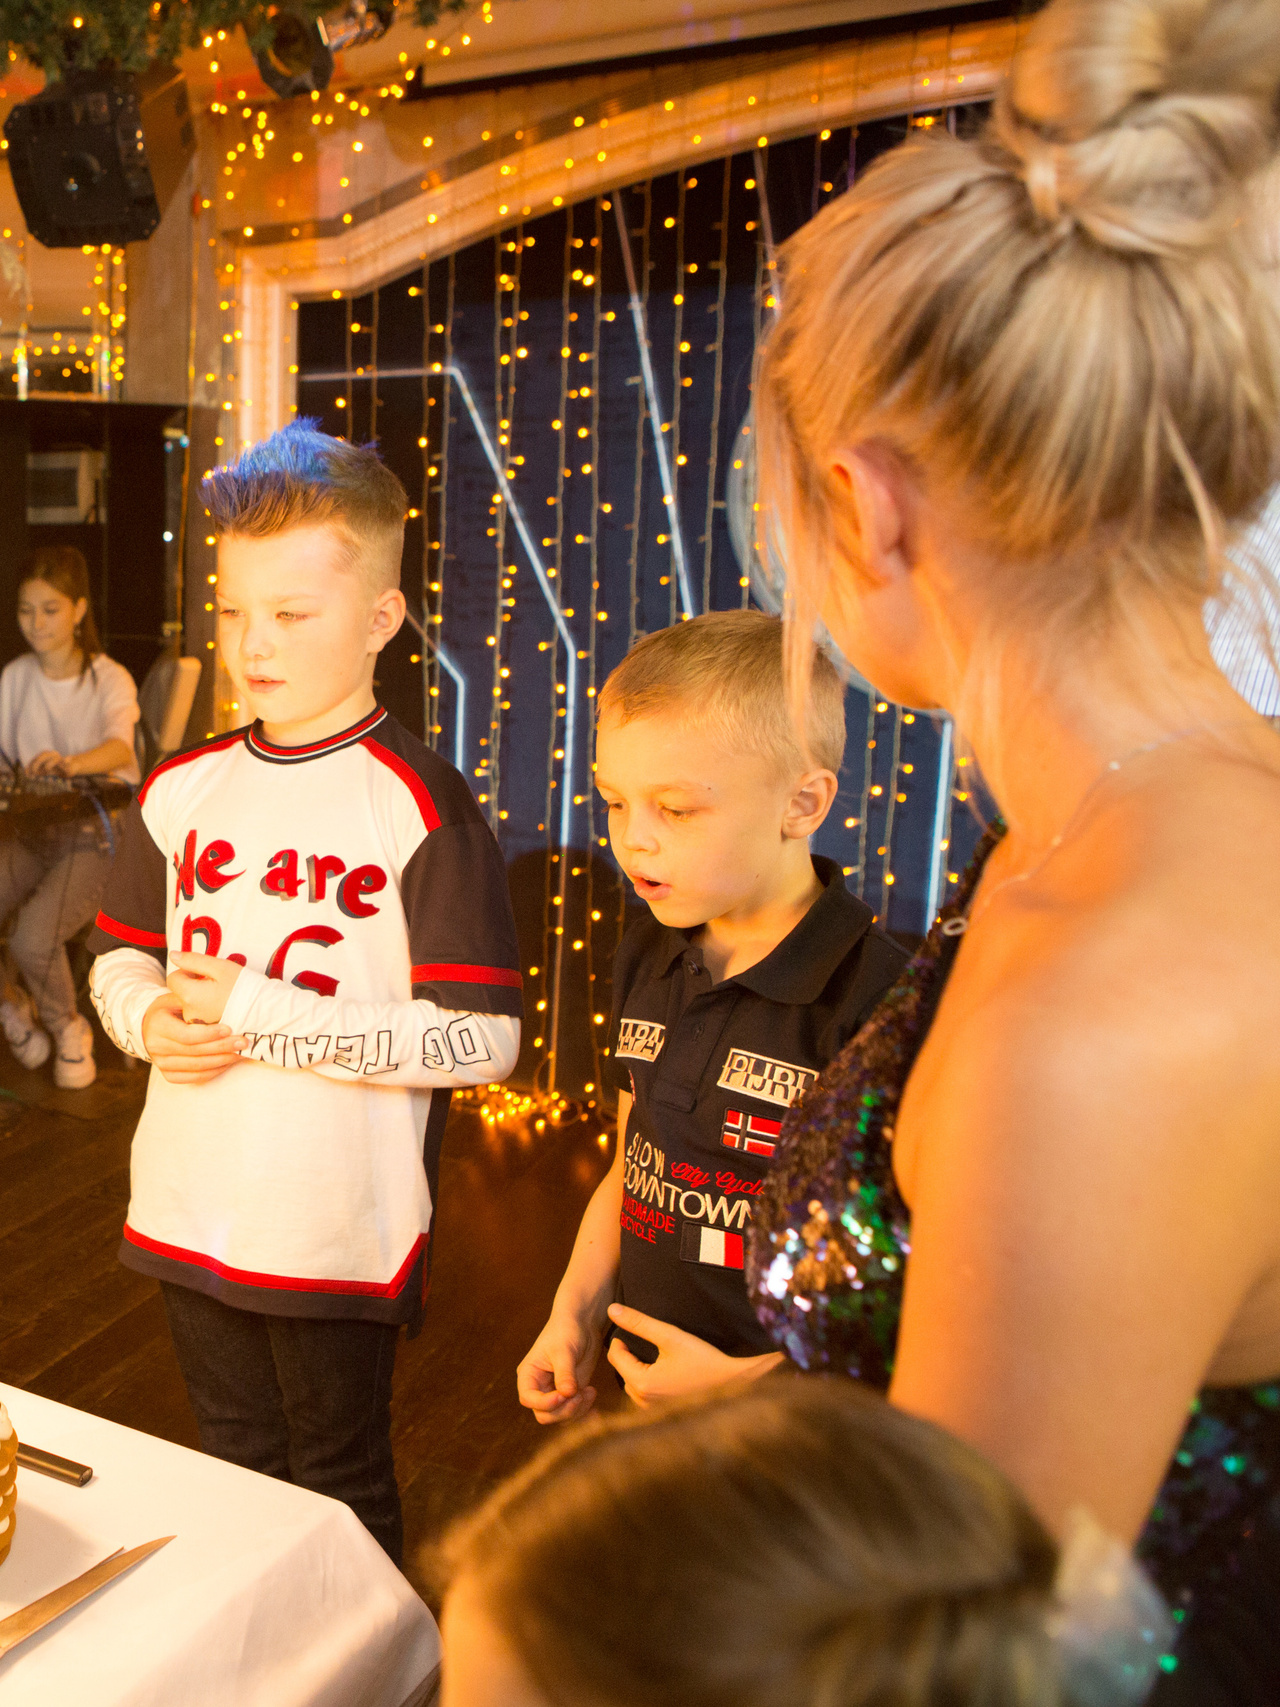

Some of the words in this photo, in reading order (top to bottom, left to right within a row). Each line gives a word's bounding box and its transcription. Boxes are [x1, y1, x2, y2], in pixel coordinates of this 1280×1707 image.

[260, 848, 387, 918] are
[239, 1029, 400, 1076] TEAM
[627, 1132, 665, 1178] SLOW
[671, 1161, 710, 1188] City
[623, 1157, 754, 1229] DOWNTOWN
